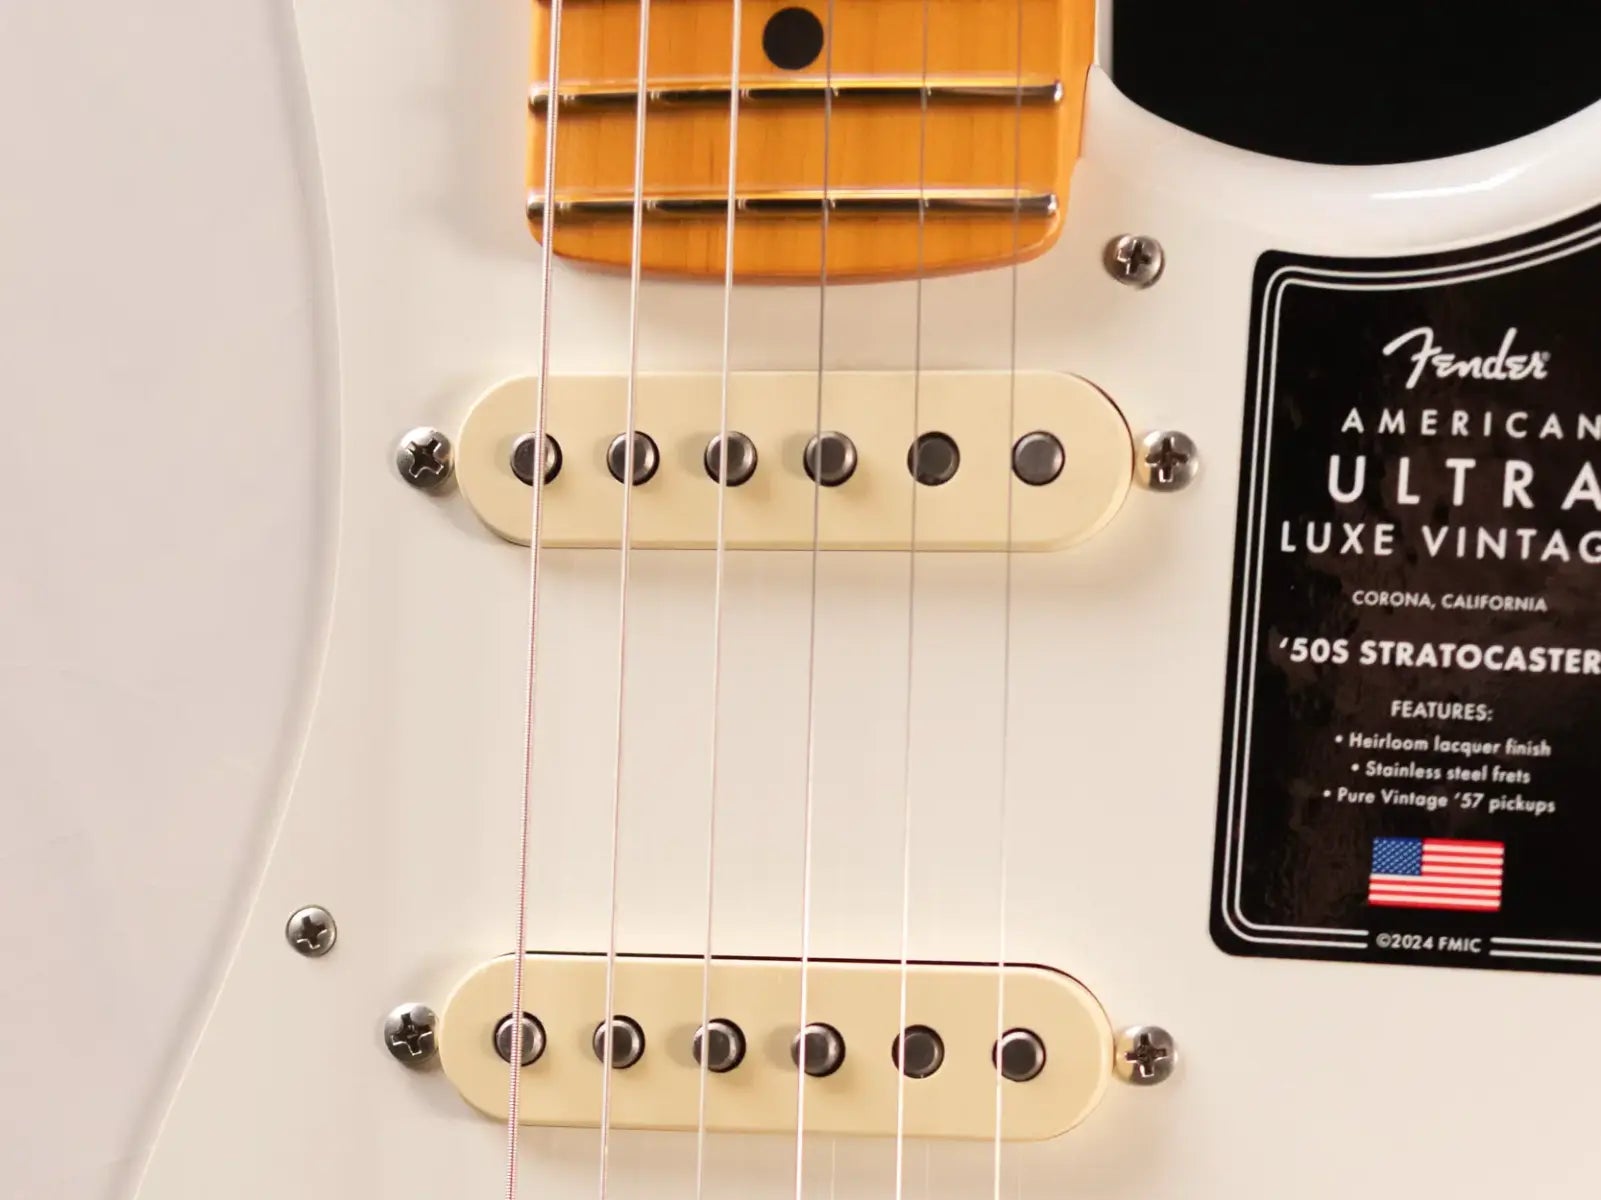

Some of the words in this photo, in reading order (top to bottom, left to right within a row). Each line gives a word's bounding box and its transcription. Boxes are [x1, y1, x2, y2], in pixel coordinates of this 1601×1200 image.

[1382, 326, 1549, 389] Fender
[1341, 408, 1601, 440] AMERICAN
[1328, 455, 1601, 511] ULTRA
[1280, 520, 1395, 556] LUXE
[1352, 590, 1436, 610] CORONA,
[1441, 594, 1548, 612] CALIFORNIA
[1359, 641, 1601, 675] STRATOCASTER
[1391, 700, 1494, 721] FEATURES:
[1349, 732, 1429, 752] Heirloom
[1434, 735, 1501, 758] lacquer
[1505, 738, 1551, 757] finish
[1365, 760, 1442, 780] Stainless
[1447, 764, 1487, 781] steel
[1492, 765, 1531, 784] frets
[1337, 786, 1375, 804] Pure
[1381, 789, 1448, 811] Vintage
[1488, 794, 1556, 816] pickups
[1376, 933, 1433, 951] ©2024
[1438, 936, 1482, 953] FMIC
